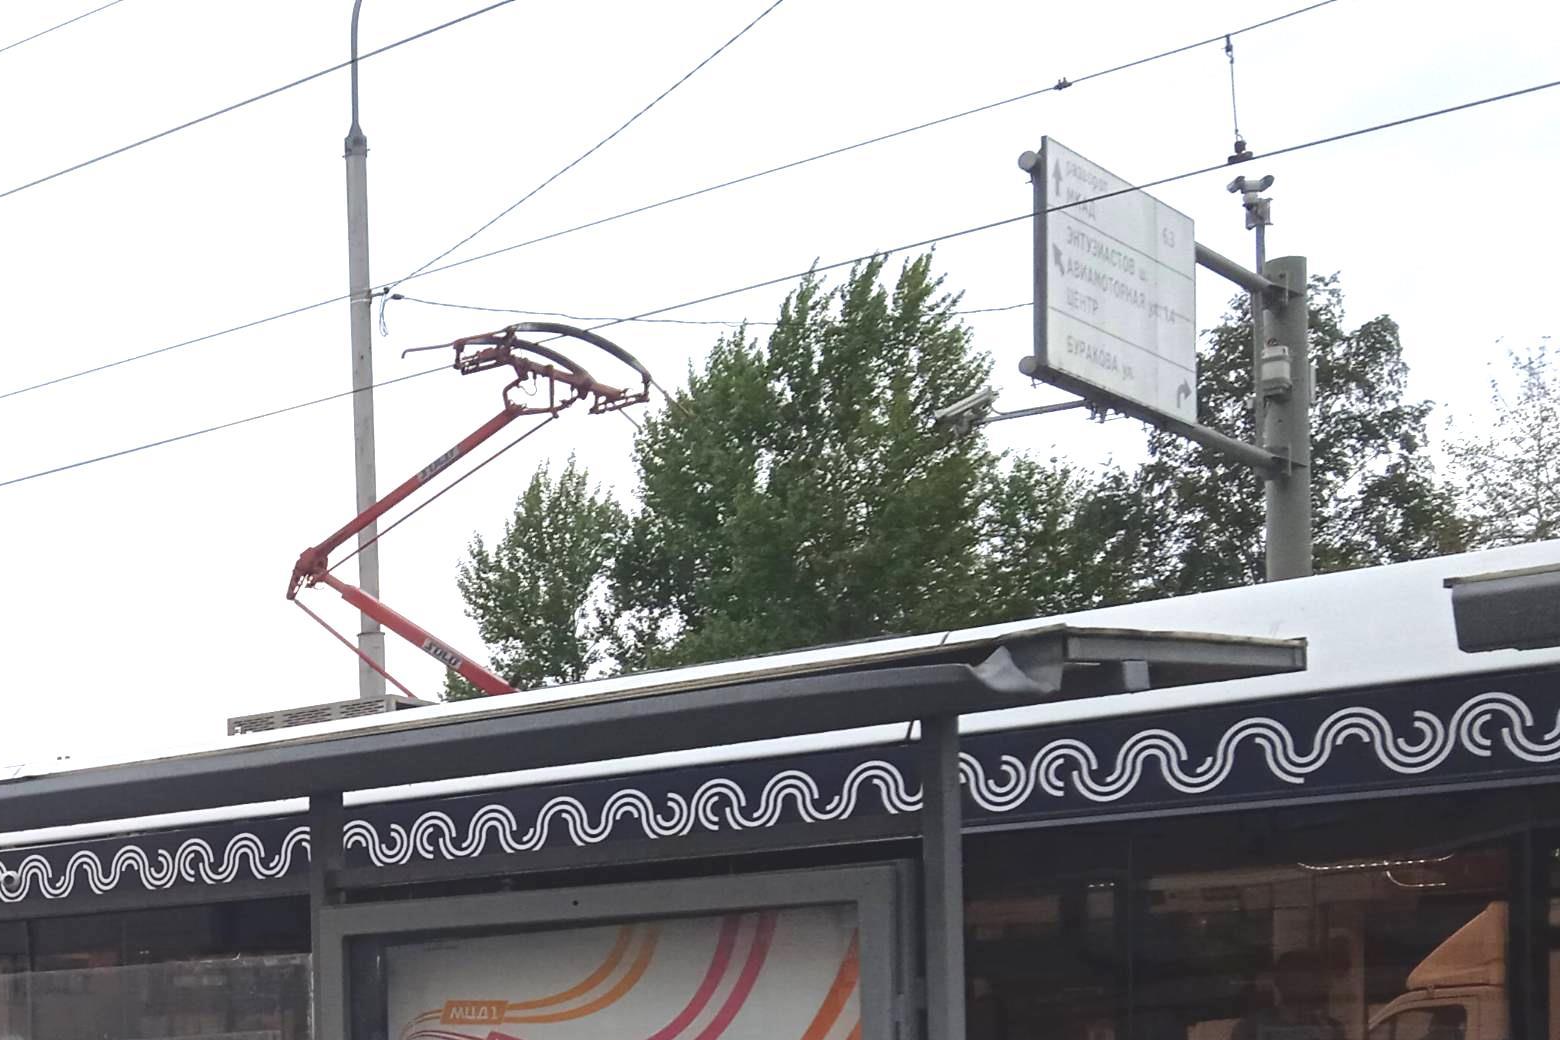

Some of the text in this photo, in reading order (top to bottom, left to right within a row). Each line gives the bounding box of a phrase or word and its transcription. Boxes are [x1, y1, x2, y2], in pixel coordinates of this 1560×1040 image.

[1066, 225, 1135, 275] ЭНТУЗИАСТОВ
[1067, 257, 1145, 307] АВИАМОТОРНАЯ
[1066, 335, 1118, 371] БУРАКОВА
[450, 1009, 498, 1021] МЦД1
